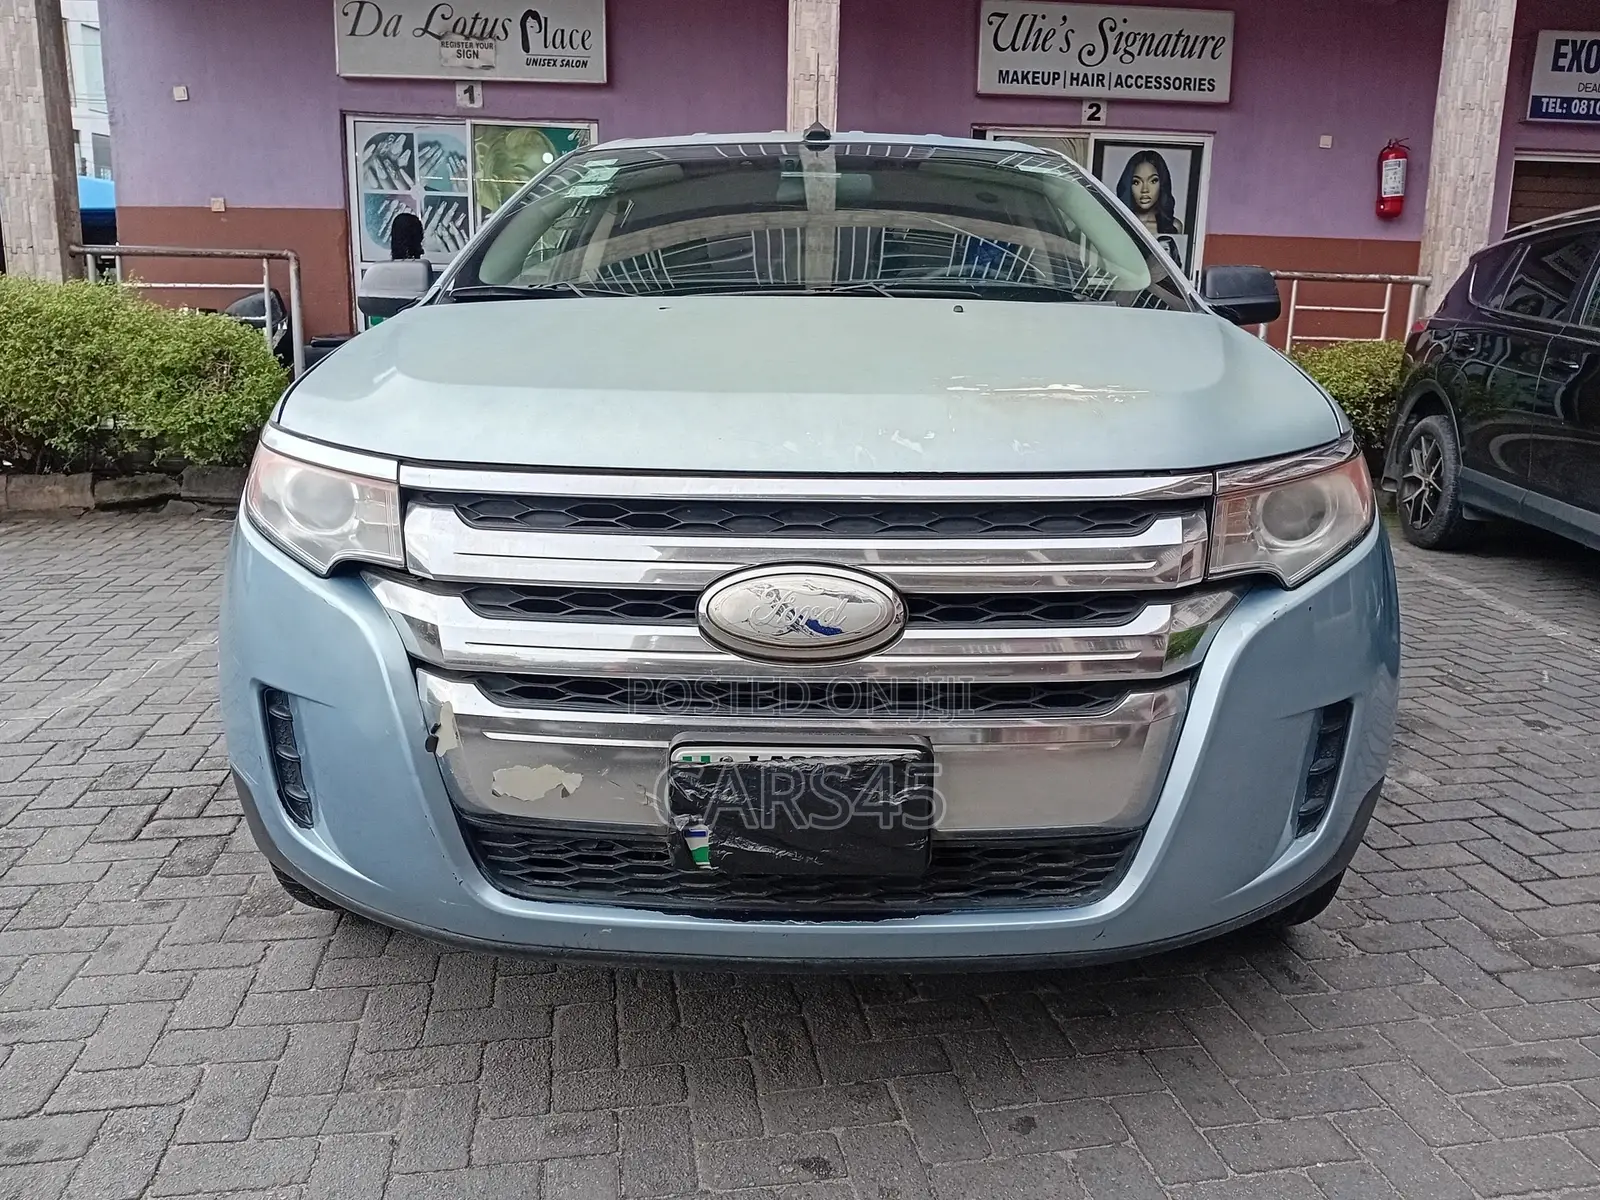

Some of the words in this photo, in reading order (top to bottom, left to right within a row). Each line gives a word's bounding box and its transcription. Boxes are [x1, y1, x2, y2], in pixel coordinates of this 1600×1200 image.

[342, 0, 403, 38] Da
[412, 3, 512, 41] Lotus
[441, 41, 473, 49] REGISTER
[476, 42, 494, 50] YOUR
[987, 12, 1075, 53] Ulie's
[1077, 16, 1226, 67] Signature
[456, 49, 479, 59] SIGN
[525, 57, 557, 68] UNISEX
[559, 58, 588, 69] SALON
[1551, 39, 1600, 74] EXO
[998, 69, 1061, 86] MAKEUP
[1069, 72, 1105, 88] HAIR
[1114, 74, 1216, 92] ACCESSORIES
[464, 85, 476, 104] 1
[1086, 103, 1101, 121] 2
[1541, 98, 1567, 113] TEL:
[749, 588, 848, 628] Ford
